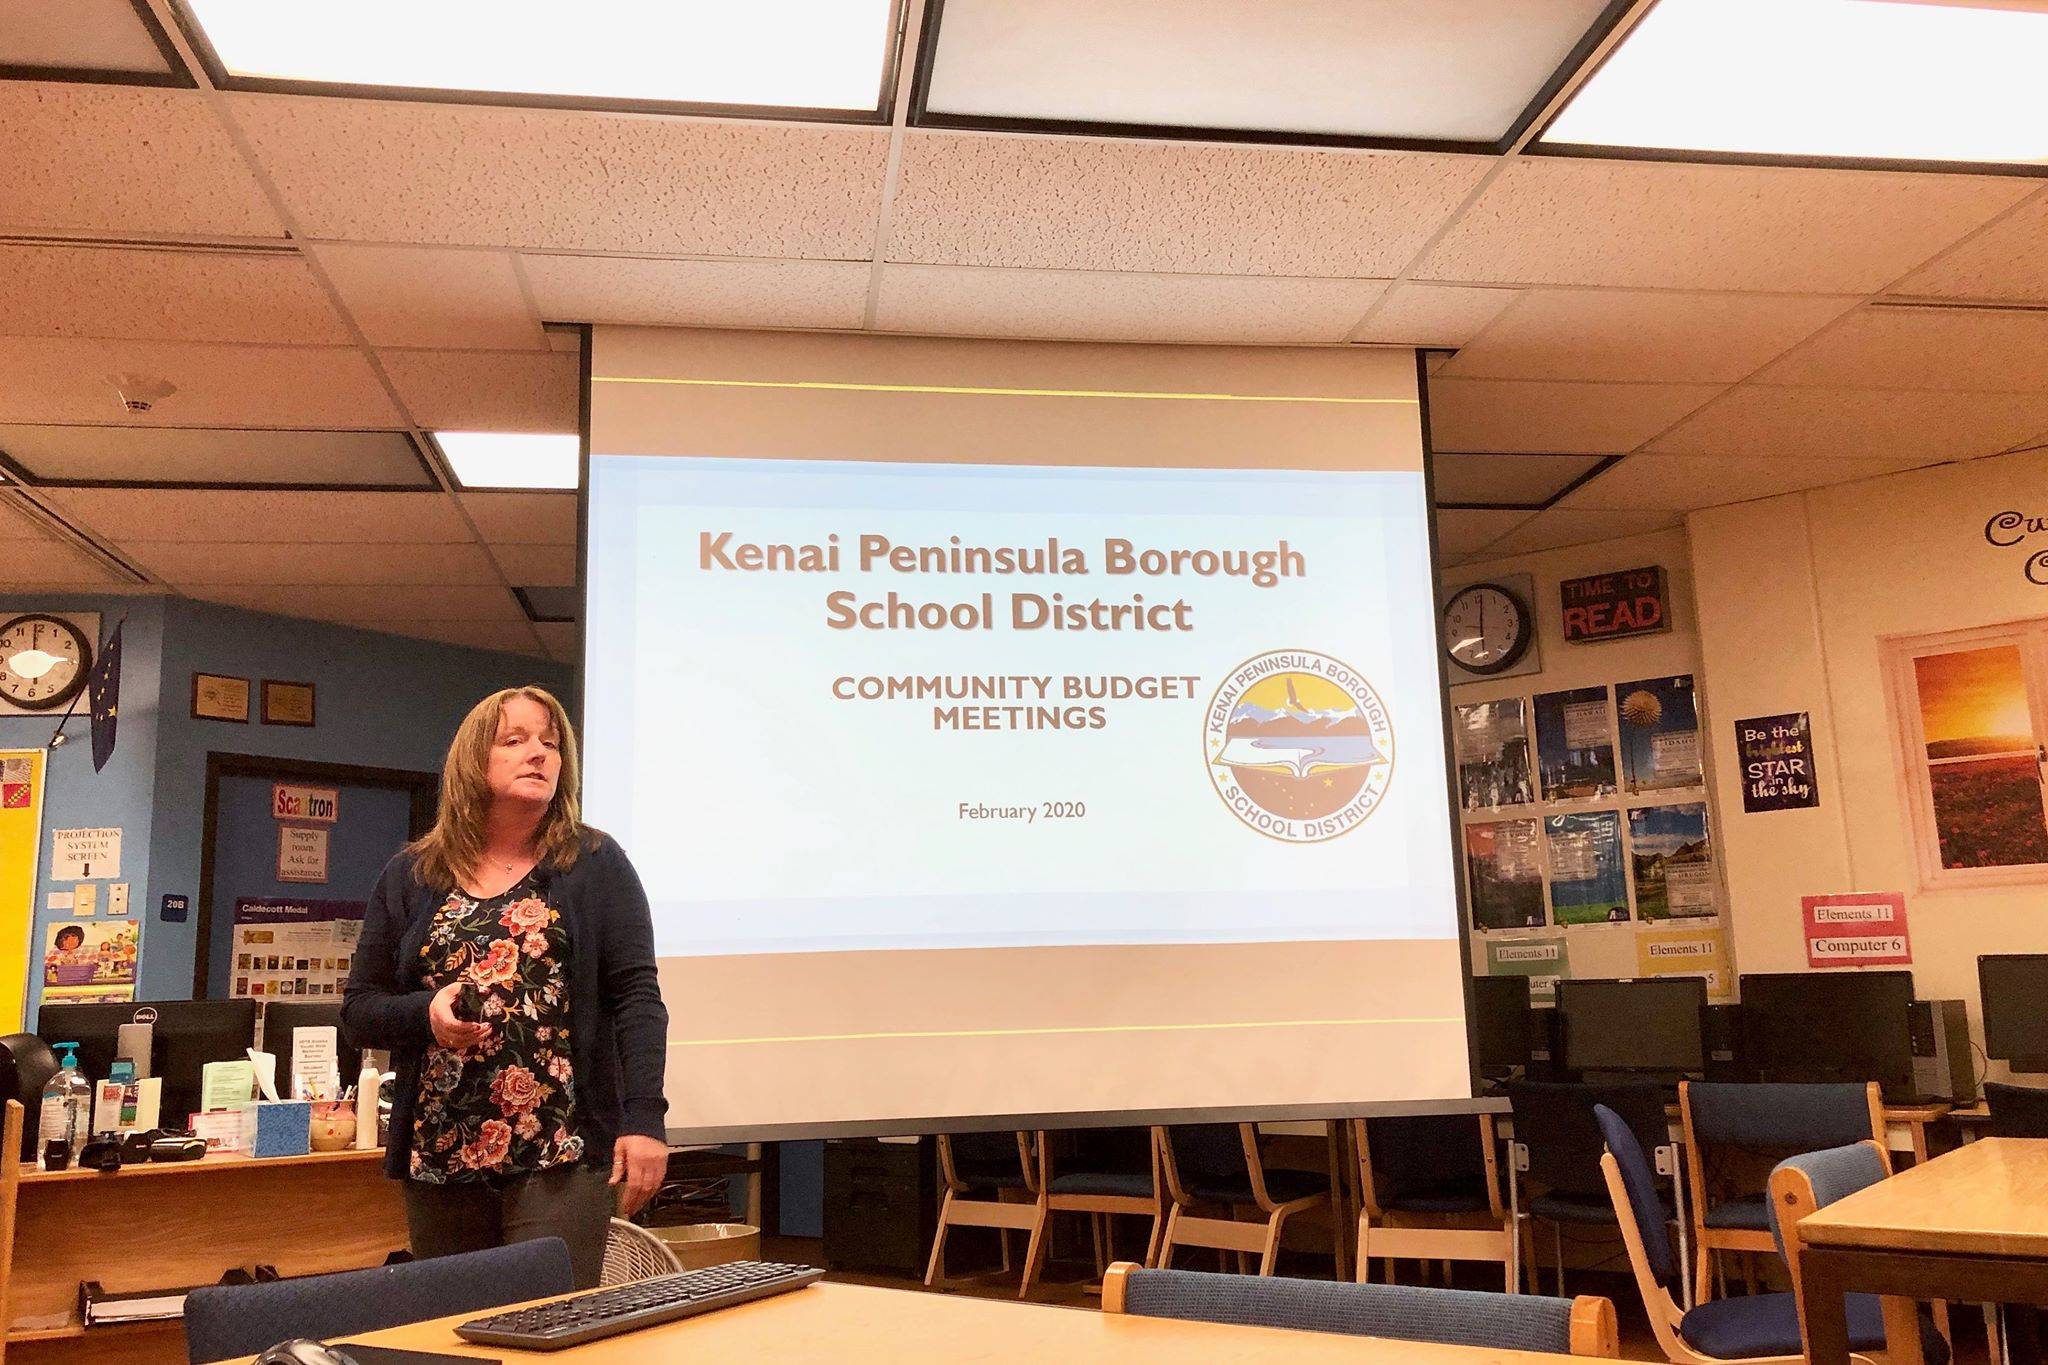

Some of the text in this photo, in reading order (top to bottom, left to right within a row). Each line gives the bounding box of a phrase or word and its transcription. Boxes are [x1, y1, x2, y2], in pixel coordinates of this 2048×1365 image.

[1985, 511, 2048, 546] Cu
[700, 532, 1307, 588] Kenai Peninsula Borough
[1566, 573, 1652, 599] TIME TO
[826, 590, 1194, 631] School District
[1563, 595, 1662, 639] READ
[65, 640, 72, 650] 2
[12, 684, 19, 693] 7
[28, 687, 36, 697] 6
[832, 676, 1201, 700] COMMUNITY BUDGET
[1210, 655, 1387, 734] KENAI PENINSULA BOROUGH
[934, 706, 1107, 730] MEETINGS
[1745, 726, 1799, 742] Be the
[1748, 759, 1806, 779] STAR
[1770, 776, 1784, 785] in
[1751, 777, 1812, 799] the sky
[278, 789, 334, 818] Scantron
[959, 801, 1086, 824] February 2020
[1225, 784, 1379, 838] SCHOOL DISTRICT
[57, 830, 120, 840] PROJECTION
[290, 829, 319, 841] Supply
[67, 841, 108, 850] SYSTEM
[67, 852, 108, 861] SCREEN
[287, 855, 319, 865] Ask for
[167, 899, 185, 909] 20B
[242, 904, 309, 914] Caldecott Medal
[1817, 908, 1890, 920] Elements 11
[1650, 943, 1712, 955] Elements 11
[1815, 938, 1901, 955] Computer 6
[1499, 948, 1556, 959] Elements 11
[1530, 980, 1548, 989] uter
[1708, 974, 1714, 984] 5
